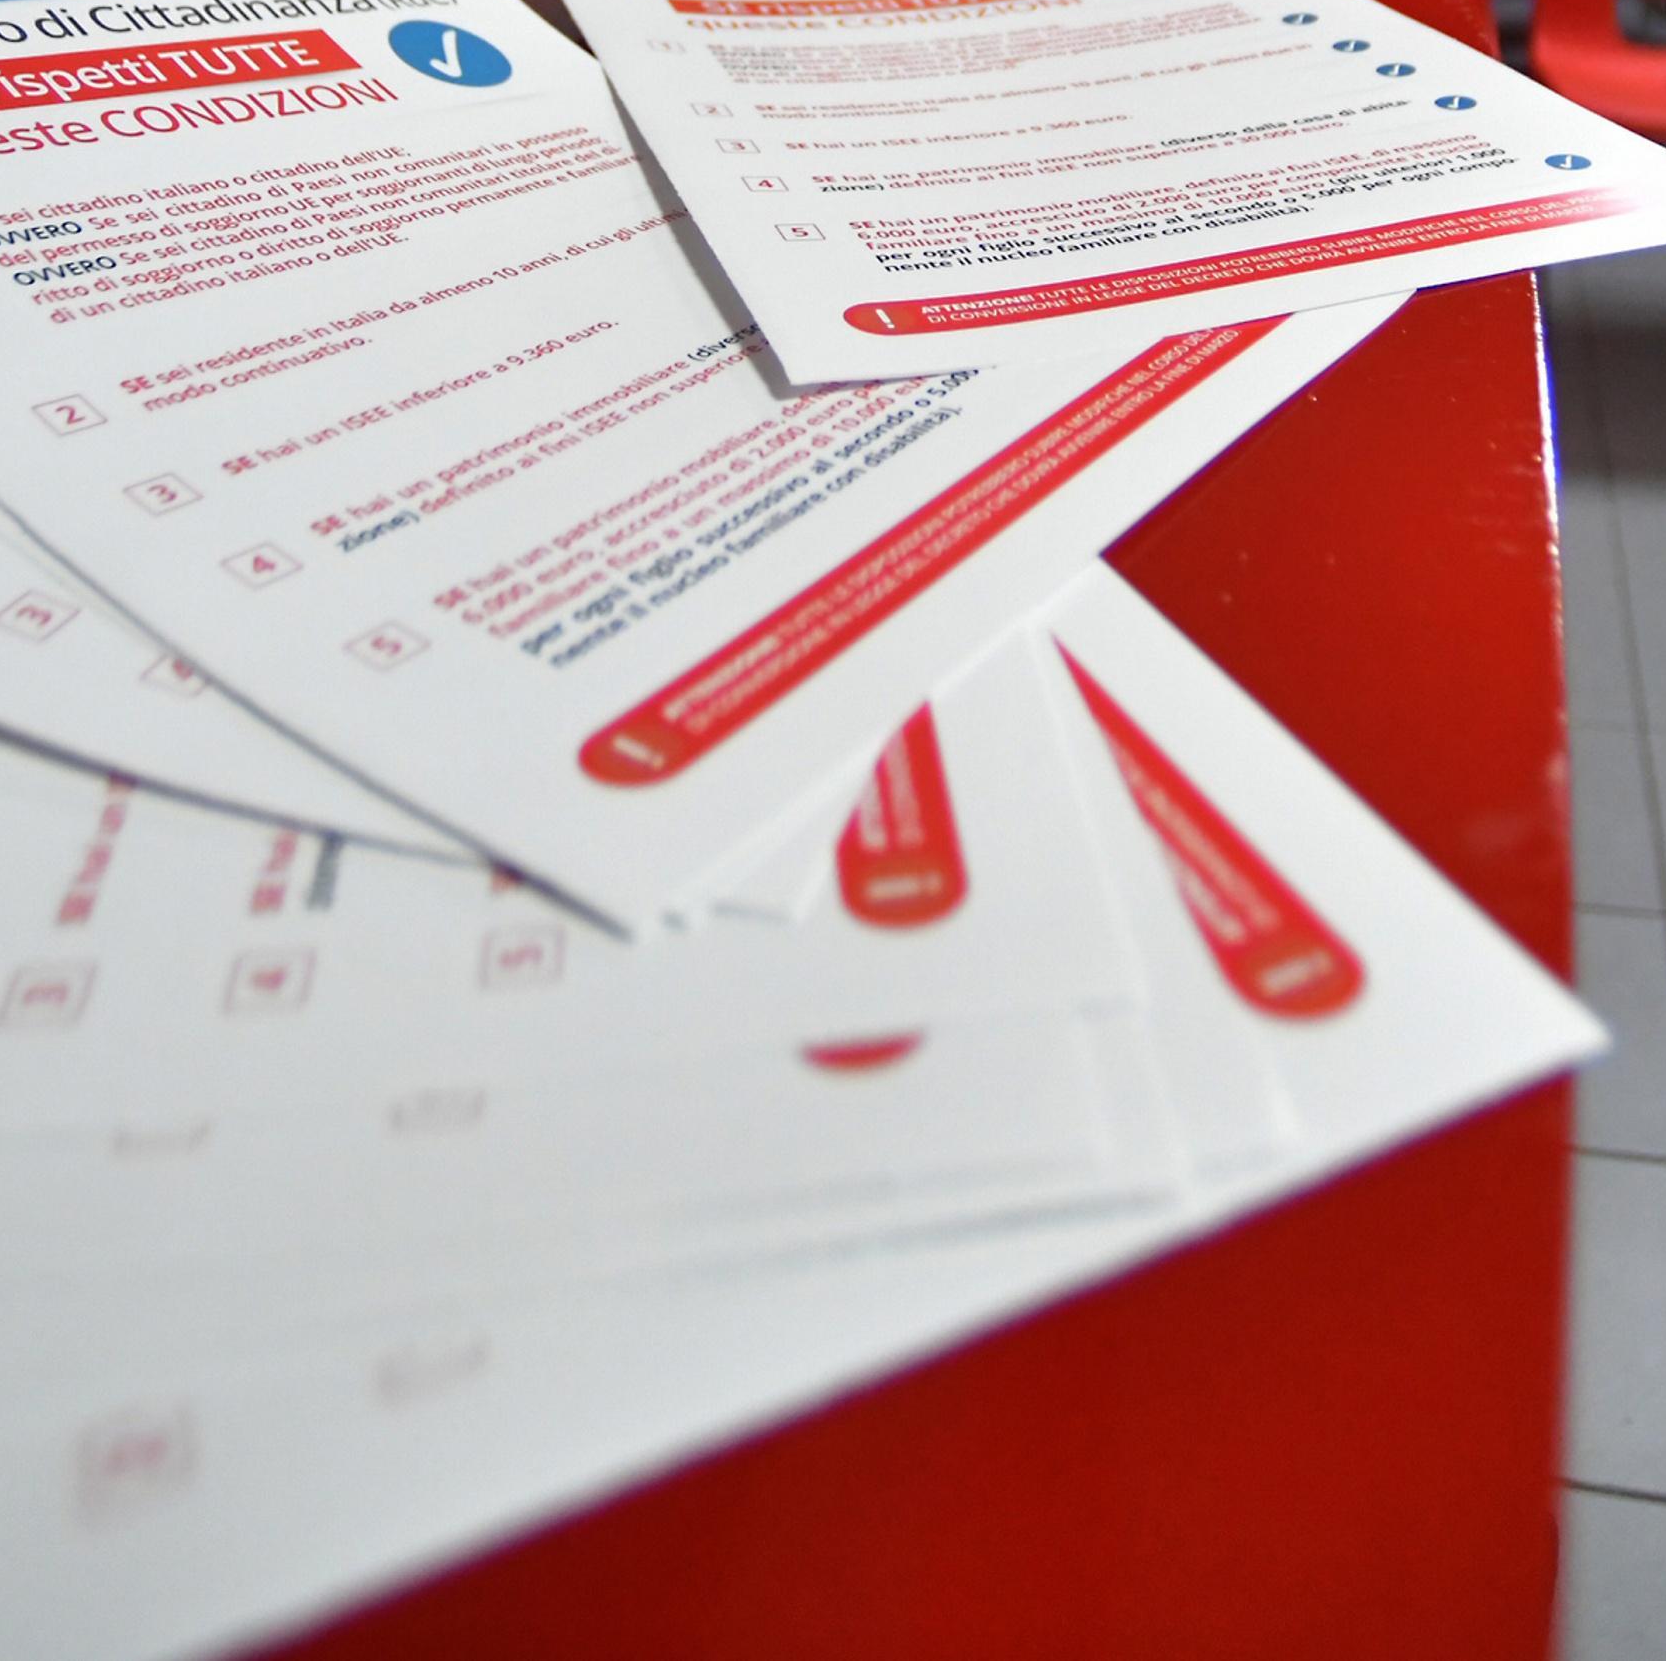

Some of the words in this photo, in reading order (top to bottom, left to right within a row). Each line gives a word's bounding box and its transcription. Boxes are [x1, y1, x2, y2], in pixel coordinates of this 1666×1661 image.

[34, 8, 89, 39] di
[155, 38, 320, 80] TUTTE
[686, 18, 829, 32] queste
[99, 77, 399, 137] CONDIZIONI
[36, 192, 145, 220] cittadino
[142, 178, 231, 202] italiano
[231, 175, 249, 187] o
[248, 160, 341, 184] cittadino
[339, 146, 412, 168] dell'UE;
[86, 215, 121, 232] Se
[123, 206, 161, 226] sei
[163, 191, 263, 218] cittadino
[266, 183, 290, 199] di
[289, 173, 348, 194] Paesi
[349, 167, 392, 183] non
[392, 145, 494, 174] comunitari
[491, 142, 516, 153] in
[874, 251, 913, 265] per
[921, 244, 973, 260] ogni
[977, 238, 1037, 253] figlio
[1041, 220, 1159, 245] successivo
[1164, 213, 1186, 226] al
[1189, 200, 1278, 221] secondo
[1282, 196, 1298, 205] o
[1300, 185, 1357, 201] 5.000
[1360, 178, 1394, 193] per
[1400, 168, 1446, 183] ogni
[1448, 157, 1516, 174] compo-
[920, 293, 1036, 315] ATTENZIONE!
[1035, 285, 1090, 301] TUTTE
[1088, 281, 1112, 293] LE
[1110, 262, 1220, 290] DISPOSIZIONI
[1218, 244, 1322, 270] POTREBBERO
[1320, 234, 1377, 254] SUBIRE
[1374, 218, 1461, 241] MODIFICHE
[1457, 213, 1496, 225] NEL
[1487, 204, 1547, 221] CORSO
[118, 374, 156, 396] SE
[154, 363, 194, 386] sei
[193, 333, 308, 374] residente
[301, 325, 334, 341] in
[327, 308, 390, 333] Italia
[387, 300, 420, 316] da
[417, 275, 495, 306] almeno
[490, 266, 521, 281] 10
[517, 251, 570, 274] anni,
[564, 244, 588, 258] di
[584, 233, 616, 251] cui
[611, 226, 638, 243] gli
[141, 382, 219, 413] modo
[218, 336, 374, 389] continuativo.
[220, 454, 259, 477] SE
[254, 437, 304, 464] hai
[303, 426, 342, 447] un
[337, 404, 395, 432] ISEE
[392, 369, 493, 413] inferiore
[491, 362, 511, 374] a
[504, 338, 566, 367] 9.360
[563, 320, 620, 344] euro.
[53, 404, 87, 427] 2
[147, 483, 178, 506] 3
